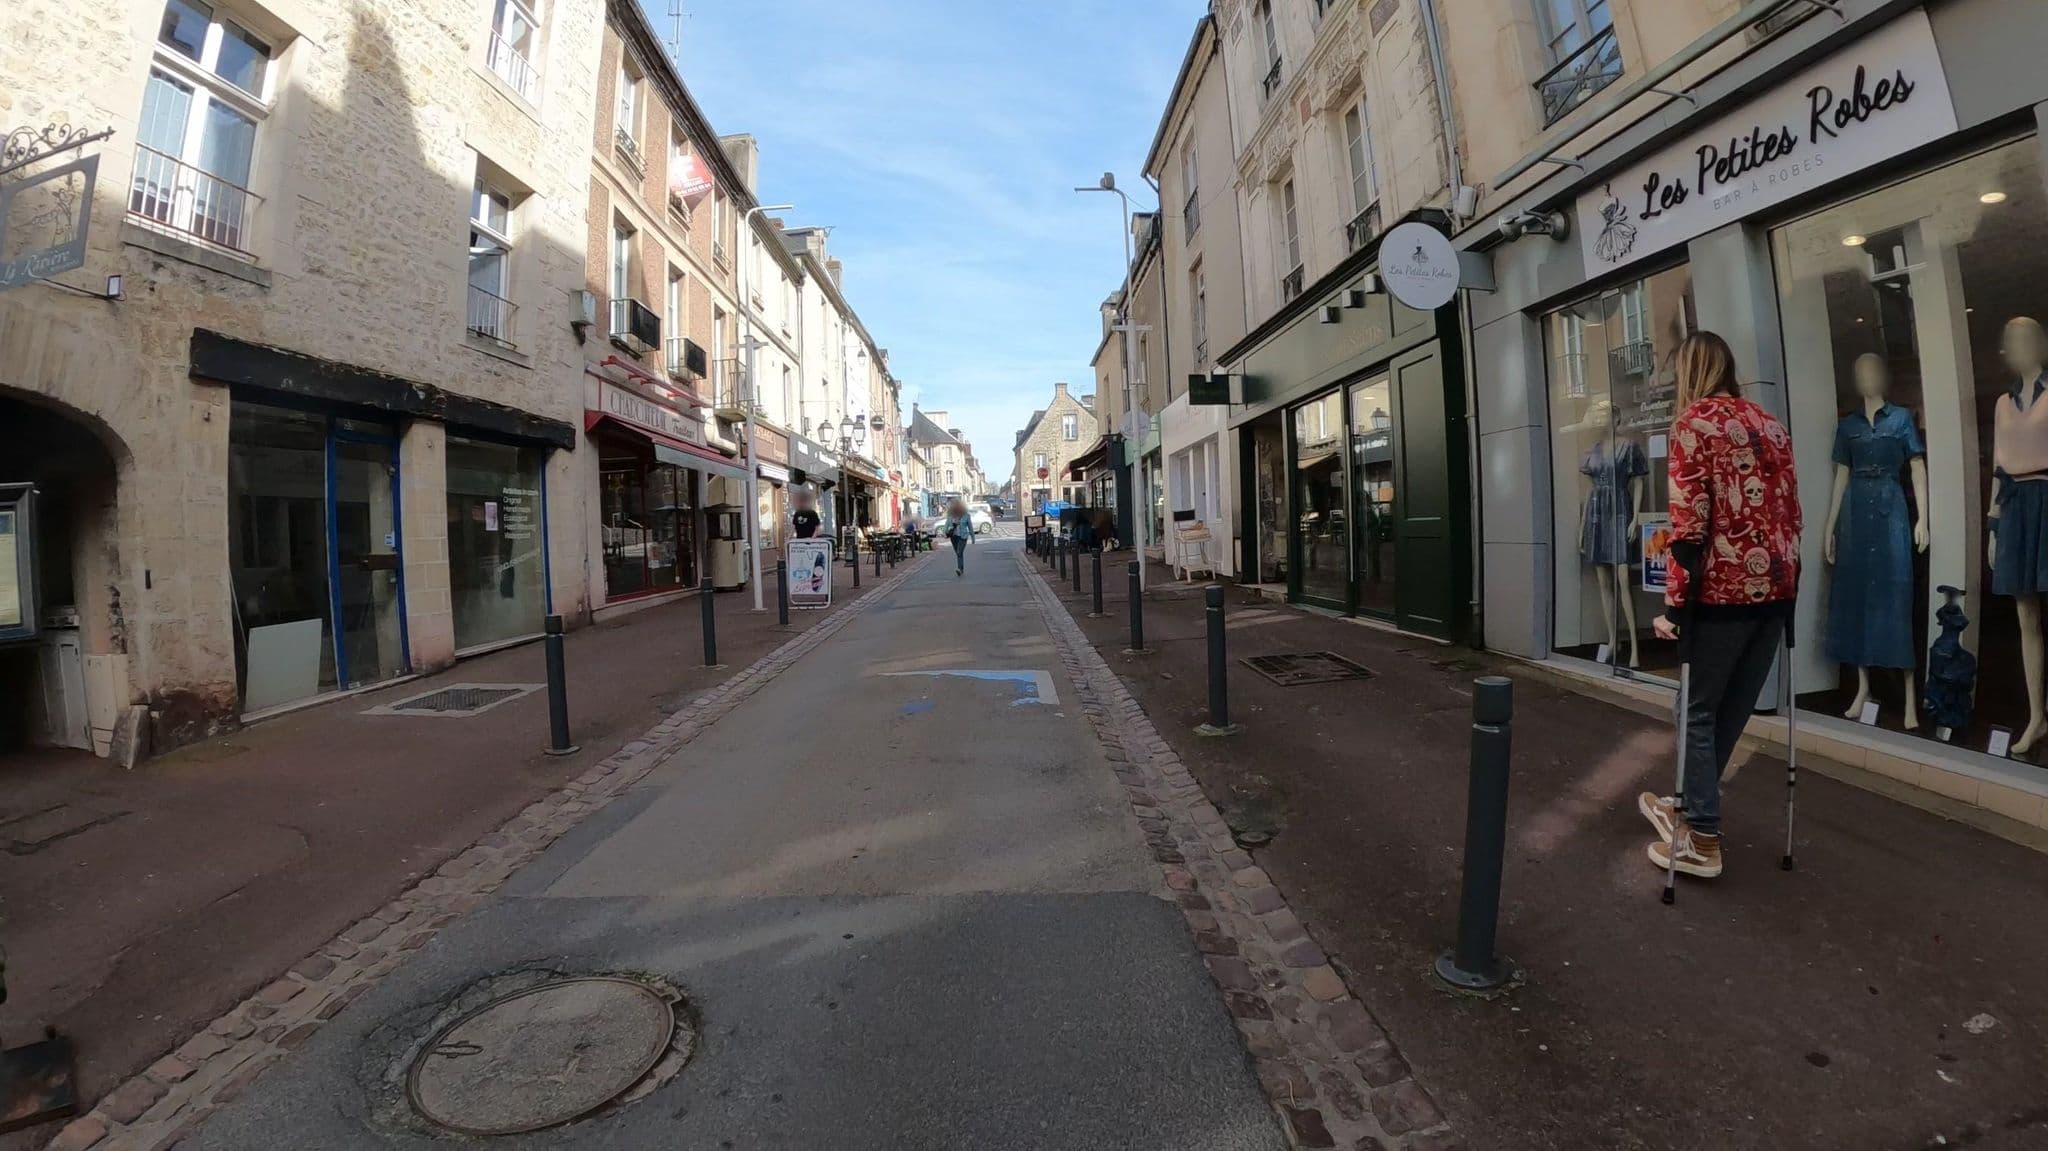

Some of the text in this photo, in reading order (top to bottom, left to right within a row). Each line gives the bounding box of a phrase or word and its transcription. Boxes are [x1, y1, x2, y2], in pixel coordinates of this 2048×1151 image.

[1639, 65, 1915, 221] Les Petites Robes
[1713, 190, 1743, 210] BAR
[1768, 154, 1824, 185] ROBES
[1388, 265, 1403, 275] Les
[1431, 266, 1452, 278] Robes
